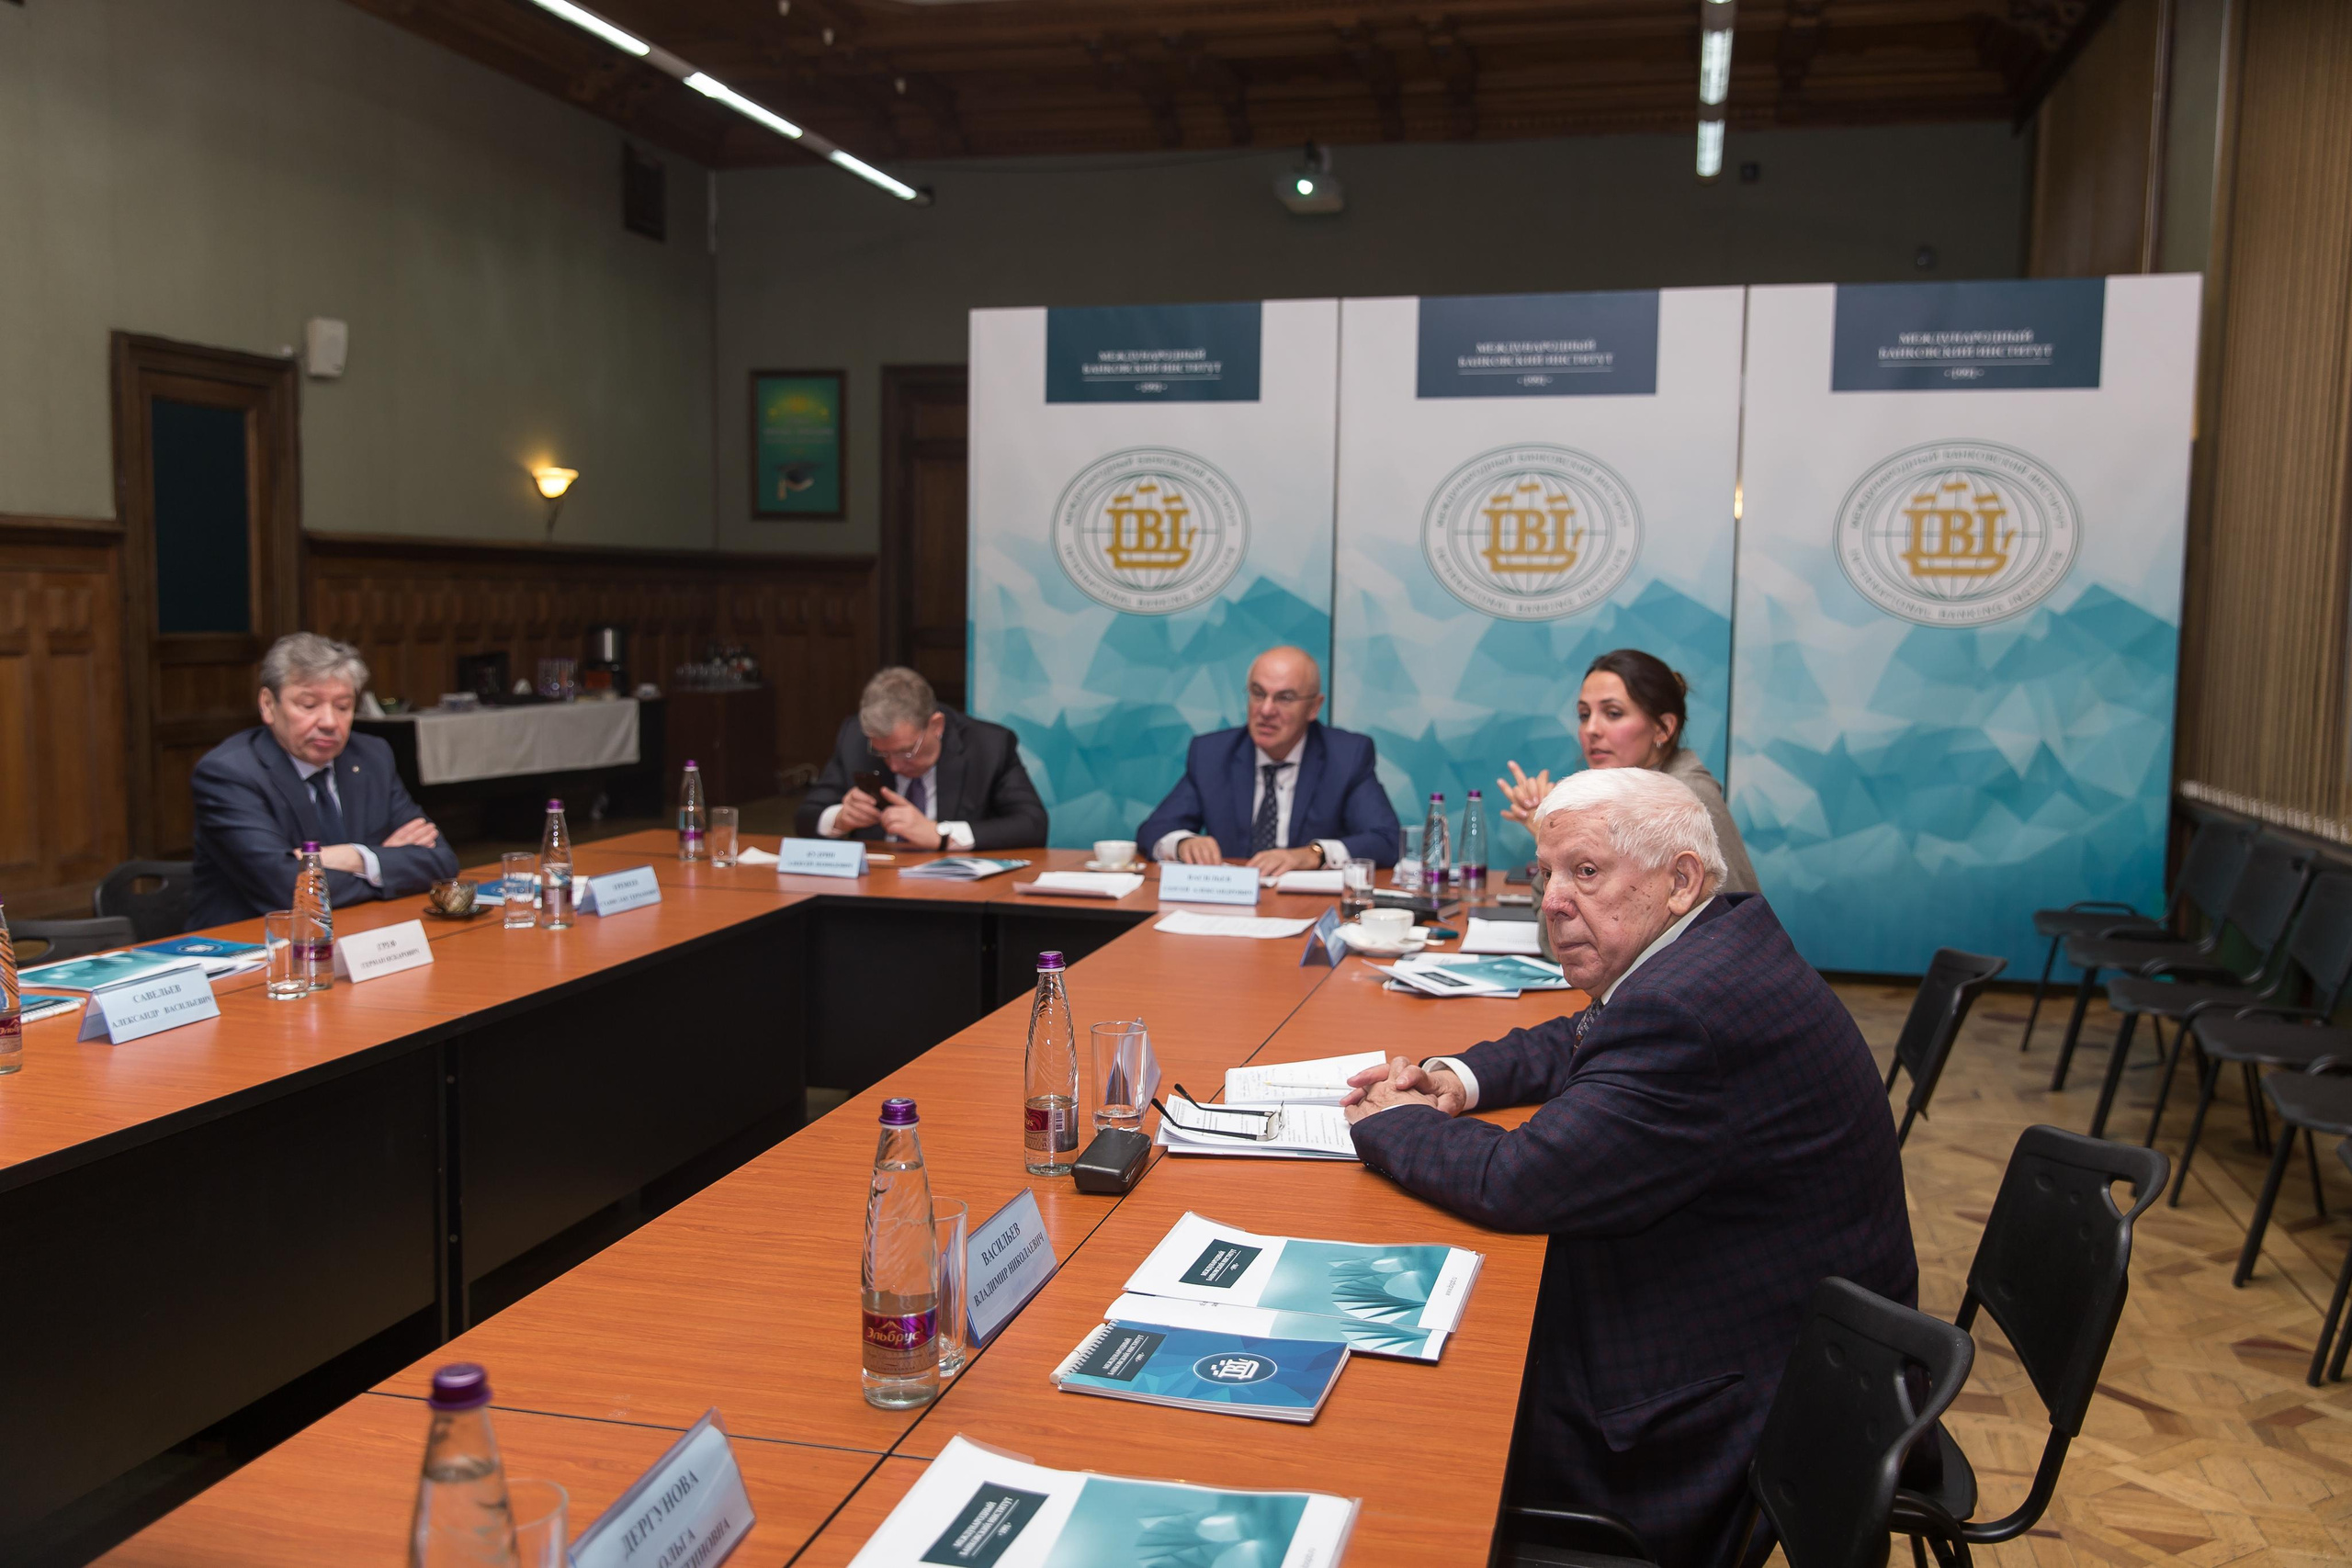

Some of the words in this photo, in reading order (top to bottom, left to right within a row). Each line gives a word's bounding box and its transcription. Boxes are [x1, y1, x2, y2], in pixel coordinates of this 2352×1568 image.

[1878, 345, 1974, 359] БАНКОВСКИЙ
[1975, 344, 2052, 359] ИНСТИТУТ
[1898, 327, 2034, 344] МЕЖДУНАРОДНЫЙ
[111, 1009, 160, 1029] АЛЕКСАНДР
[164, 995, 212, 1014] ВАСИЛЬЕВИЧ
[132, 984, 182, 1004] САВЕЛЬЕВ
[980, 1222, 1022, 1267] ВАСИЛЬЕВ
[973, 1267, 1009, 1307] ВЛАДИМИР
[1008, 1232, 1045, 1275] НИКОЛАЕВИЧ
[867, 1326, 921, 1347] Эльбрус
[1102, 1337, 1132, 1370] МЕЖДУНАРОДНЫЙ
[1107, 1350, 1131, 1375] БАНКОВСКИЙ
[1125, 1335, 1145, 1355] ИНСТИТУТ
[620, 1470, 699, 1561] ДЕРГУНОВА
[953, 1501, 997, 1548] МЕЖДУНАРОДНЫЙ
[958, 1520, 993, 1556] БАНКОВСКИЙ
[986, 1496, 1012, 1526] ИНСТИТУТ
[658, 1529, 696, 1568] ОЛЬГА
